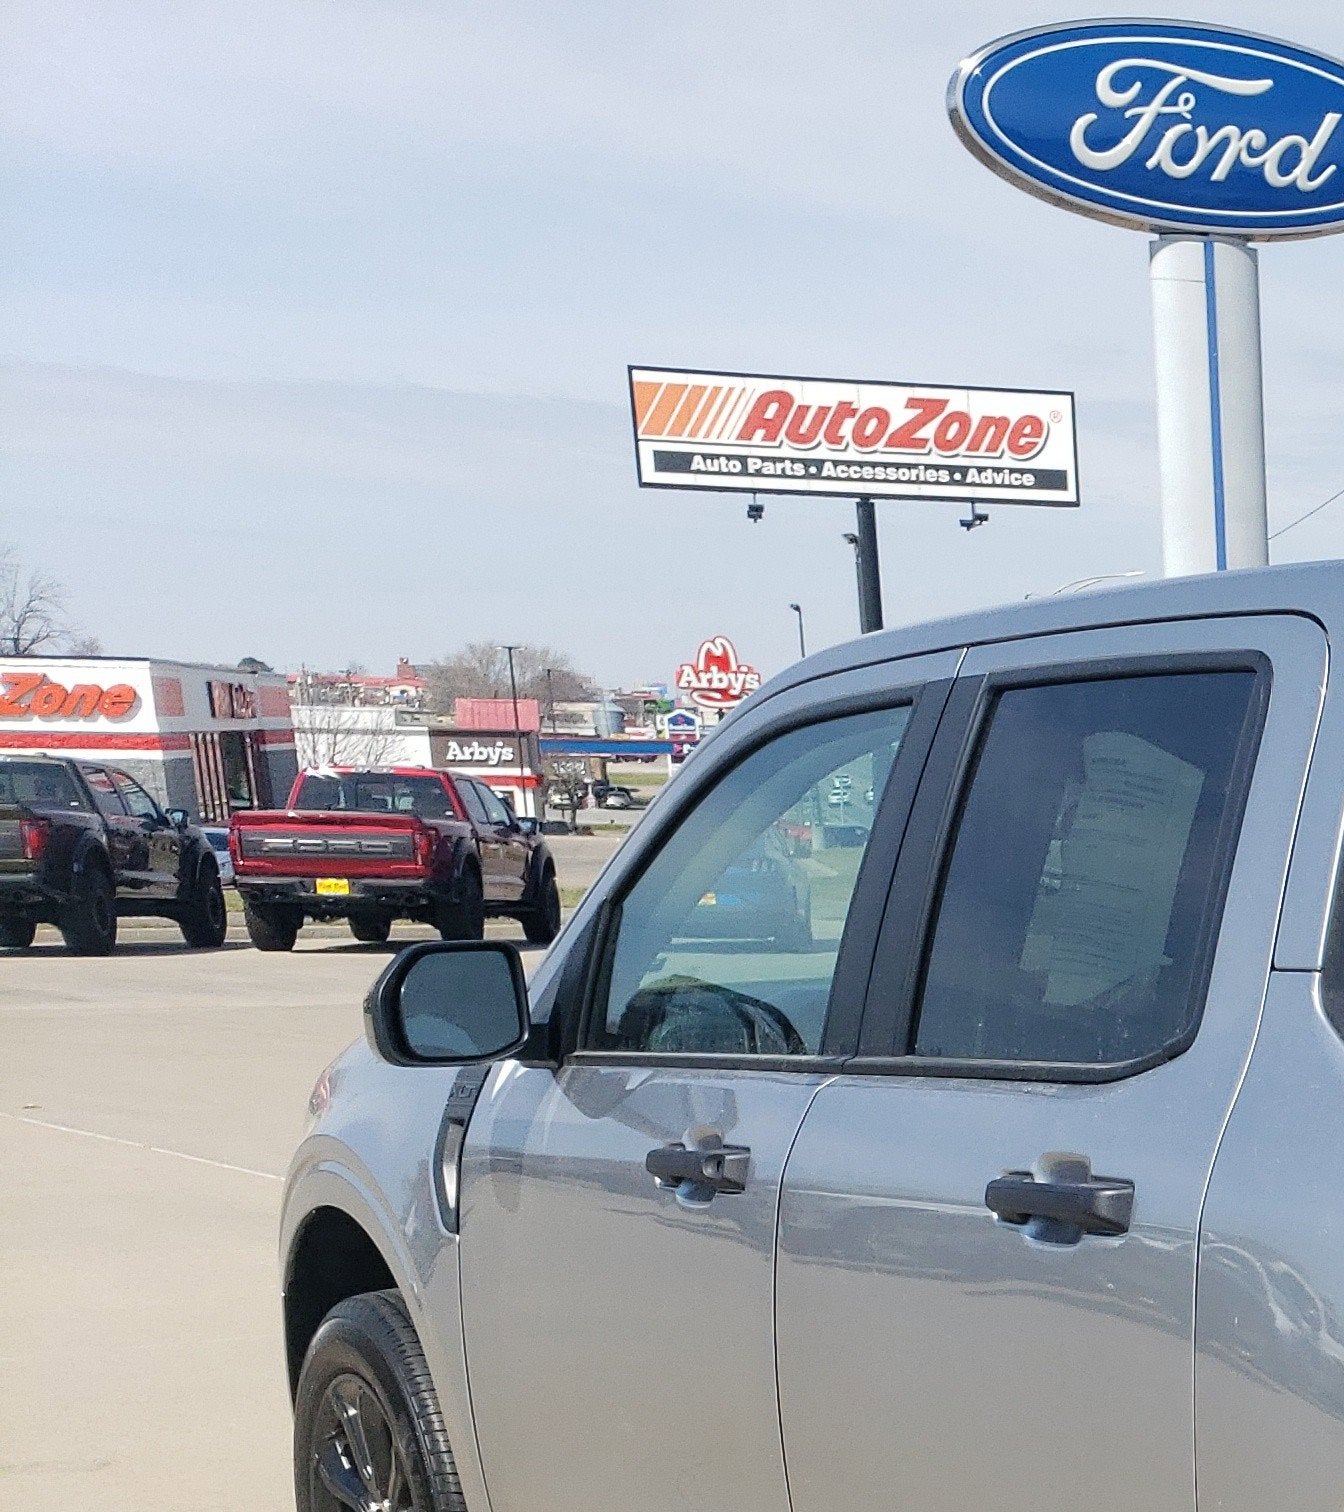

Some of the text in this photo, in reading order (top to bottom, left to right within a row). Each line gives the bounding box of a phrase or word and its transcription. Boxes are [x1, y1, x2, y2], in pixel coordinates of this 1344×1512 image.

[1070, 58, 1342, 192] Ford
[738, 389, 1048, 458] AutoZone
[690, 454, 1035, 486] Auto Parts Accessories Advice
[678, 664, 761, 696] Arby's
[446, 741, 515, 765] Arby's
